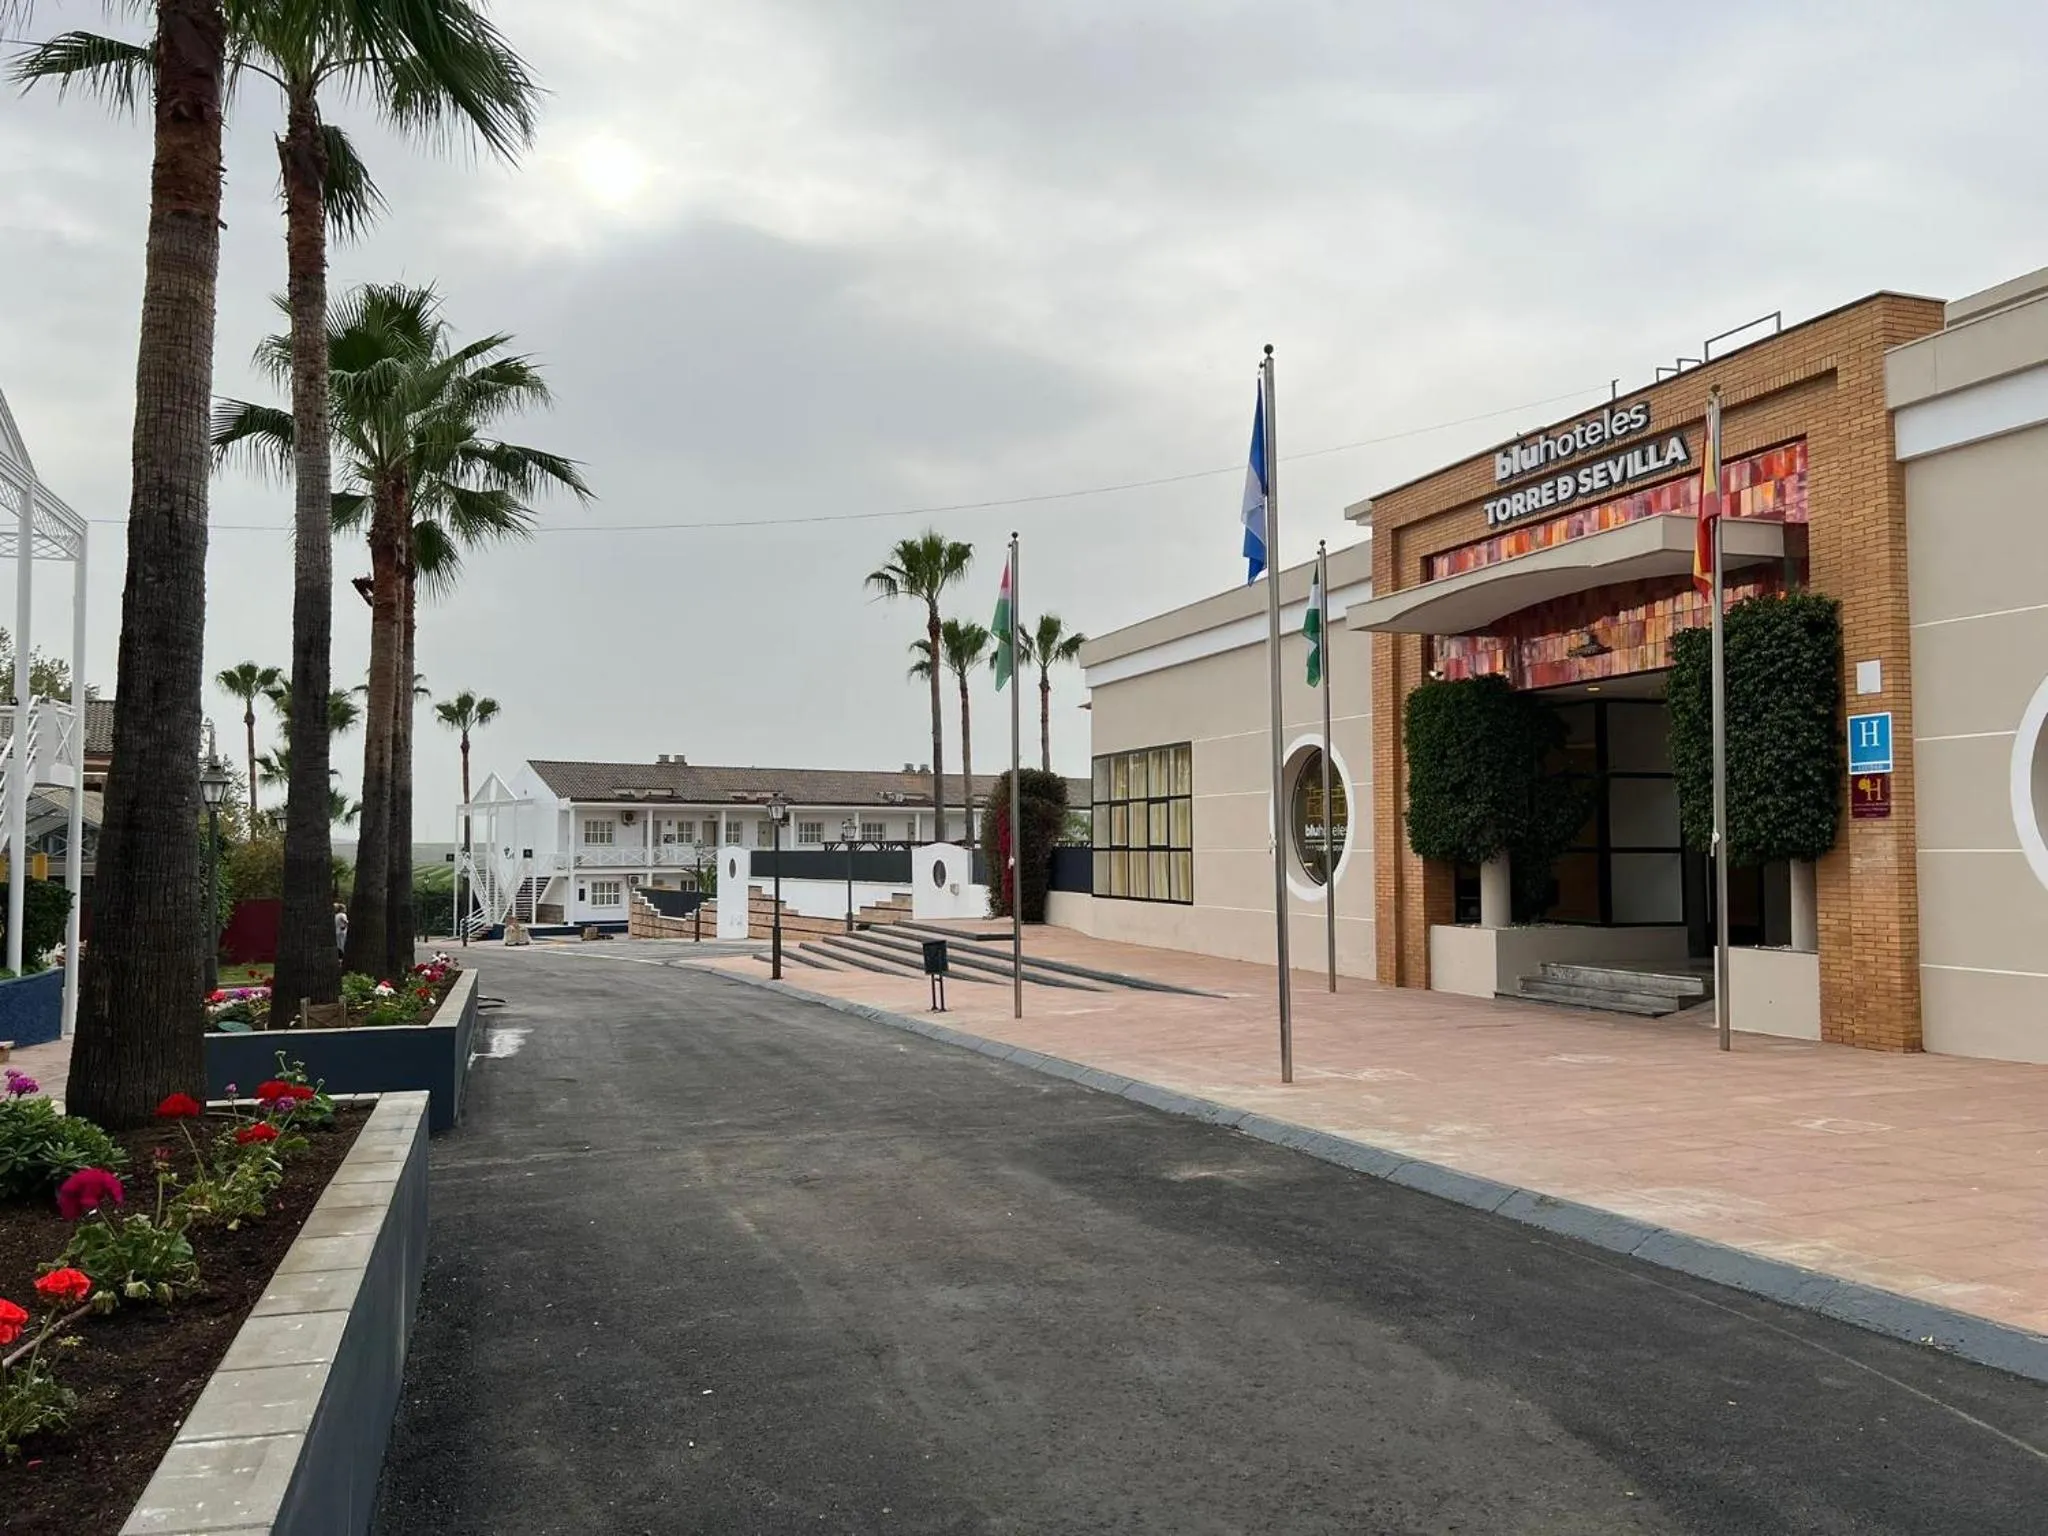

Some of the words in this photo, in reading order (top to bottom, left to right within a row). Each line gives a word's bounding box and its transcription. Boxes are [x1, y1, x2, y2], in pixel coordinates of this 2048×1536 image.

[1495, 403, 1648, 482] bluhoteles
[1577, 436, 1688, 495] SEVILLA
[1859, 720, 1880, 747] H
[1866, 777, 1884, 801] H
